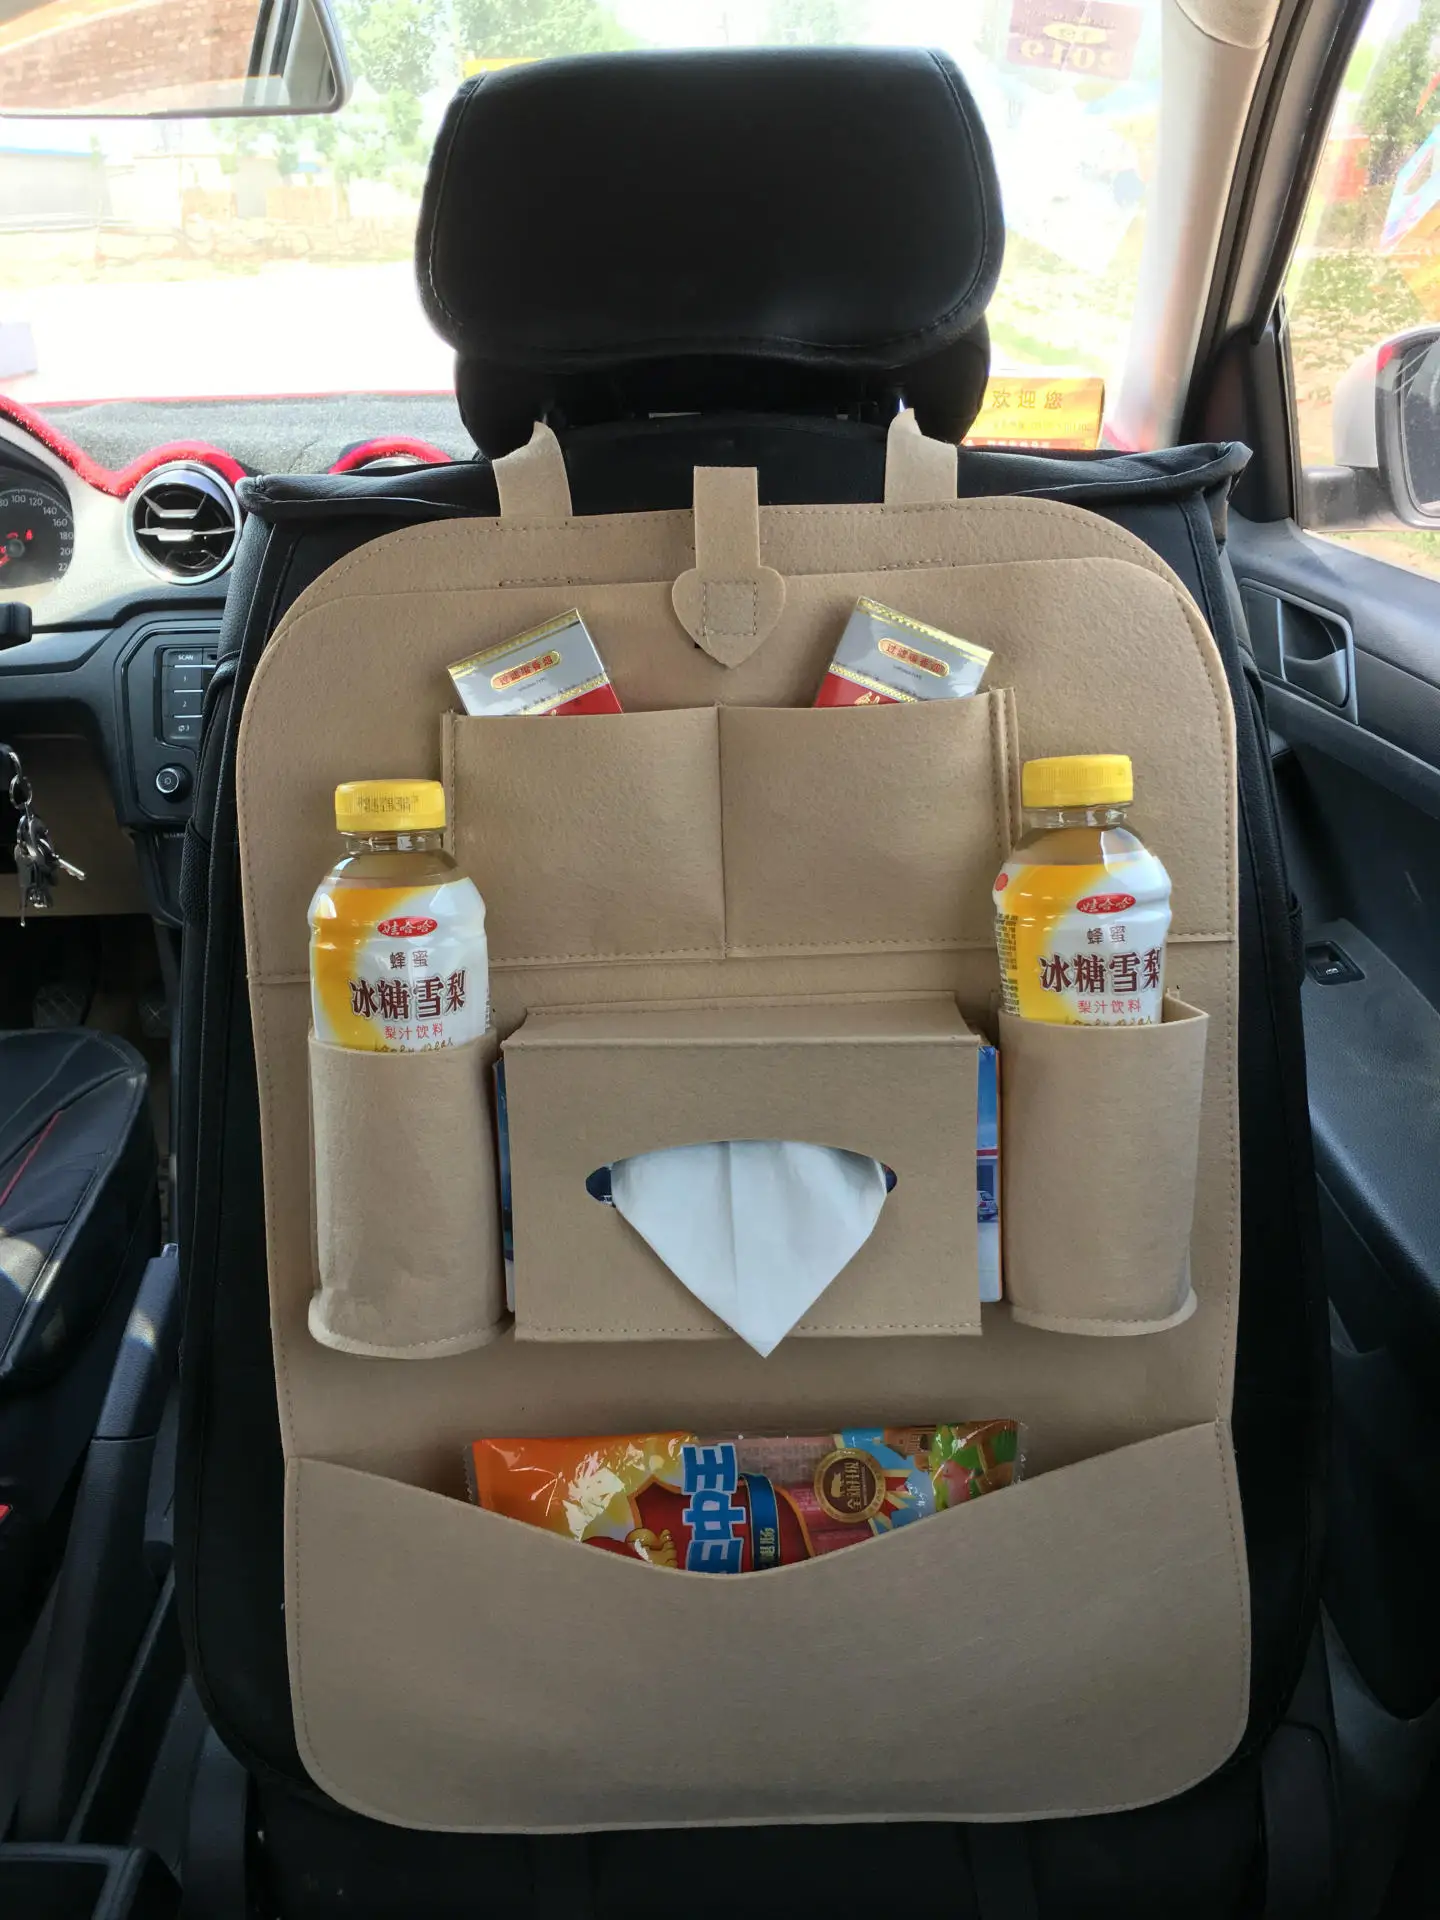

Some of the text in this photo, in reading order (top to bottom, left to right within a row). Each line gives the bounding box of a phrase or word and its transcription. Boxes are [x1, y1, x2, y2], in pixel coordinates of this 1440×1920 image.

[992, 388, 1063, 410] 欢迎您
[11, 494, 26, 503] 100
[28, 497, 43, 506] 120
[42, 506, 58, 515] 140
[52, 517, 68, 527] 160
[58, 562, 69, 571] 22
[182, 700, 187, 708] 2
[1078, 895, 1133, 914] 娃哈哈
[380, 918, 434, 937] 娃哈哈
[1086, 925, 1127, 945] 蜂蜜
[389, 950, 429, 969] 蜂蜜
[1037, 947, 1162, 994] 冰糖雪梨
[350, 969, 467, 1021] 冰糖雪梨
[1077, 999, 1143, 1015] 梨汁饮料
[383, 1022, 444, 1041] 梨汁饮料
[681, 1442, 746, 1573] 王中王
